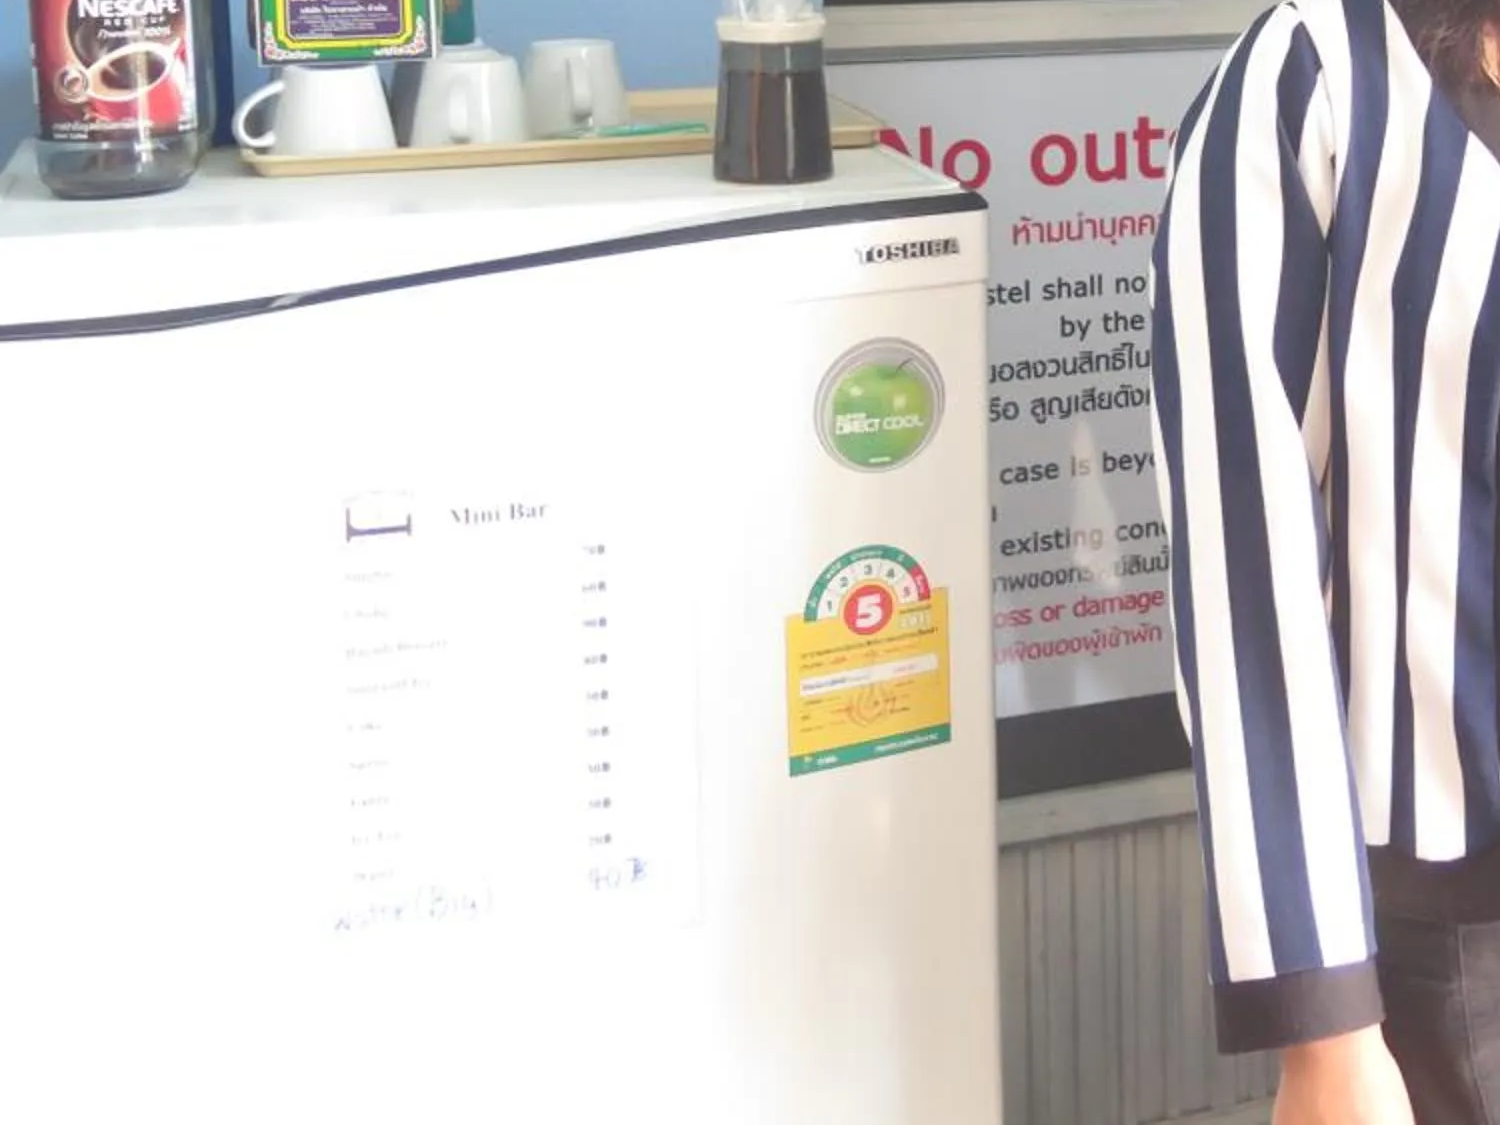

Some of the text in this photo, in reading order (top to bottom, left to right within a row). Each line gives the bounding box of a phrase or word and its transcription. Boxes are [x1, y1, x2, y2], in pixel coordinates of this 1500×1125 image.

[1030, 115, 1177, 187] out
[855, 237, 960, 265] TOSHIBA
[1042, 274, 1103, 301] shall
[1059, 311, 1146, 341] by the
[1000, 462, 1060, 486] case
[1070, 455, 1091, 477] is
[450, 501, 550, 526] Mini Bar
[1000, 526, 1104, 557] existing
[863, 564, 873, 576] 3
[886, 568, 895, 579] 4
[855, 593, 883, 629] 5
[1040, 603, 1067, 623] or
[1072, 588, 1166, 618] damage
